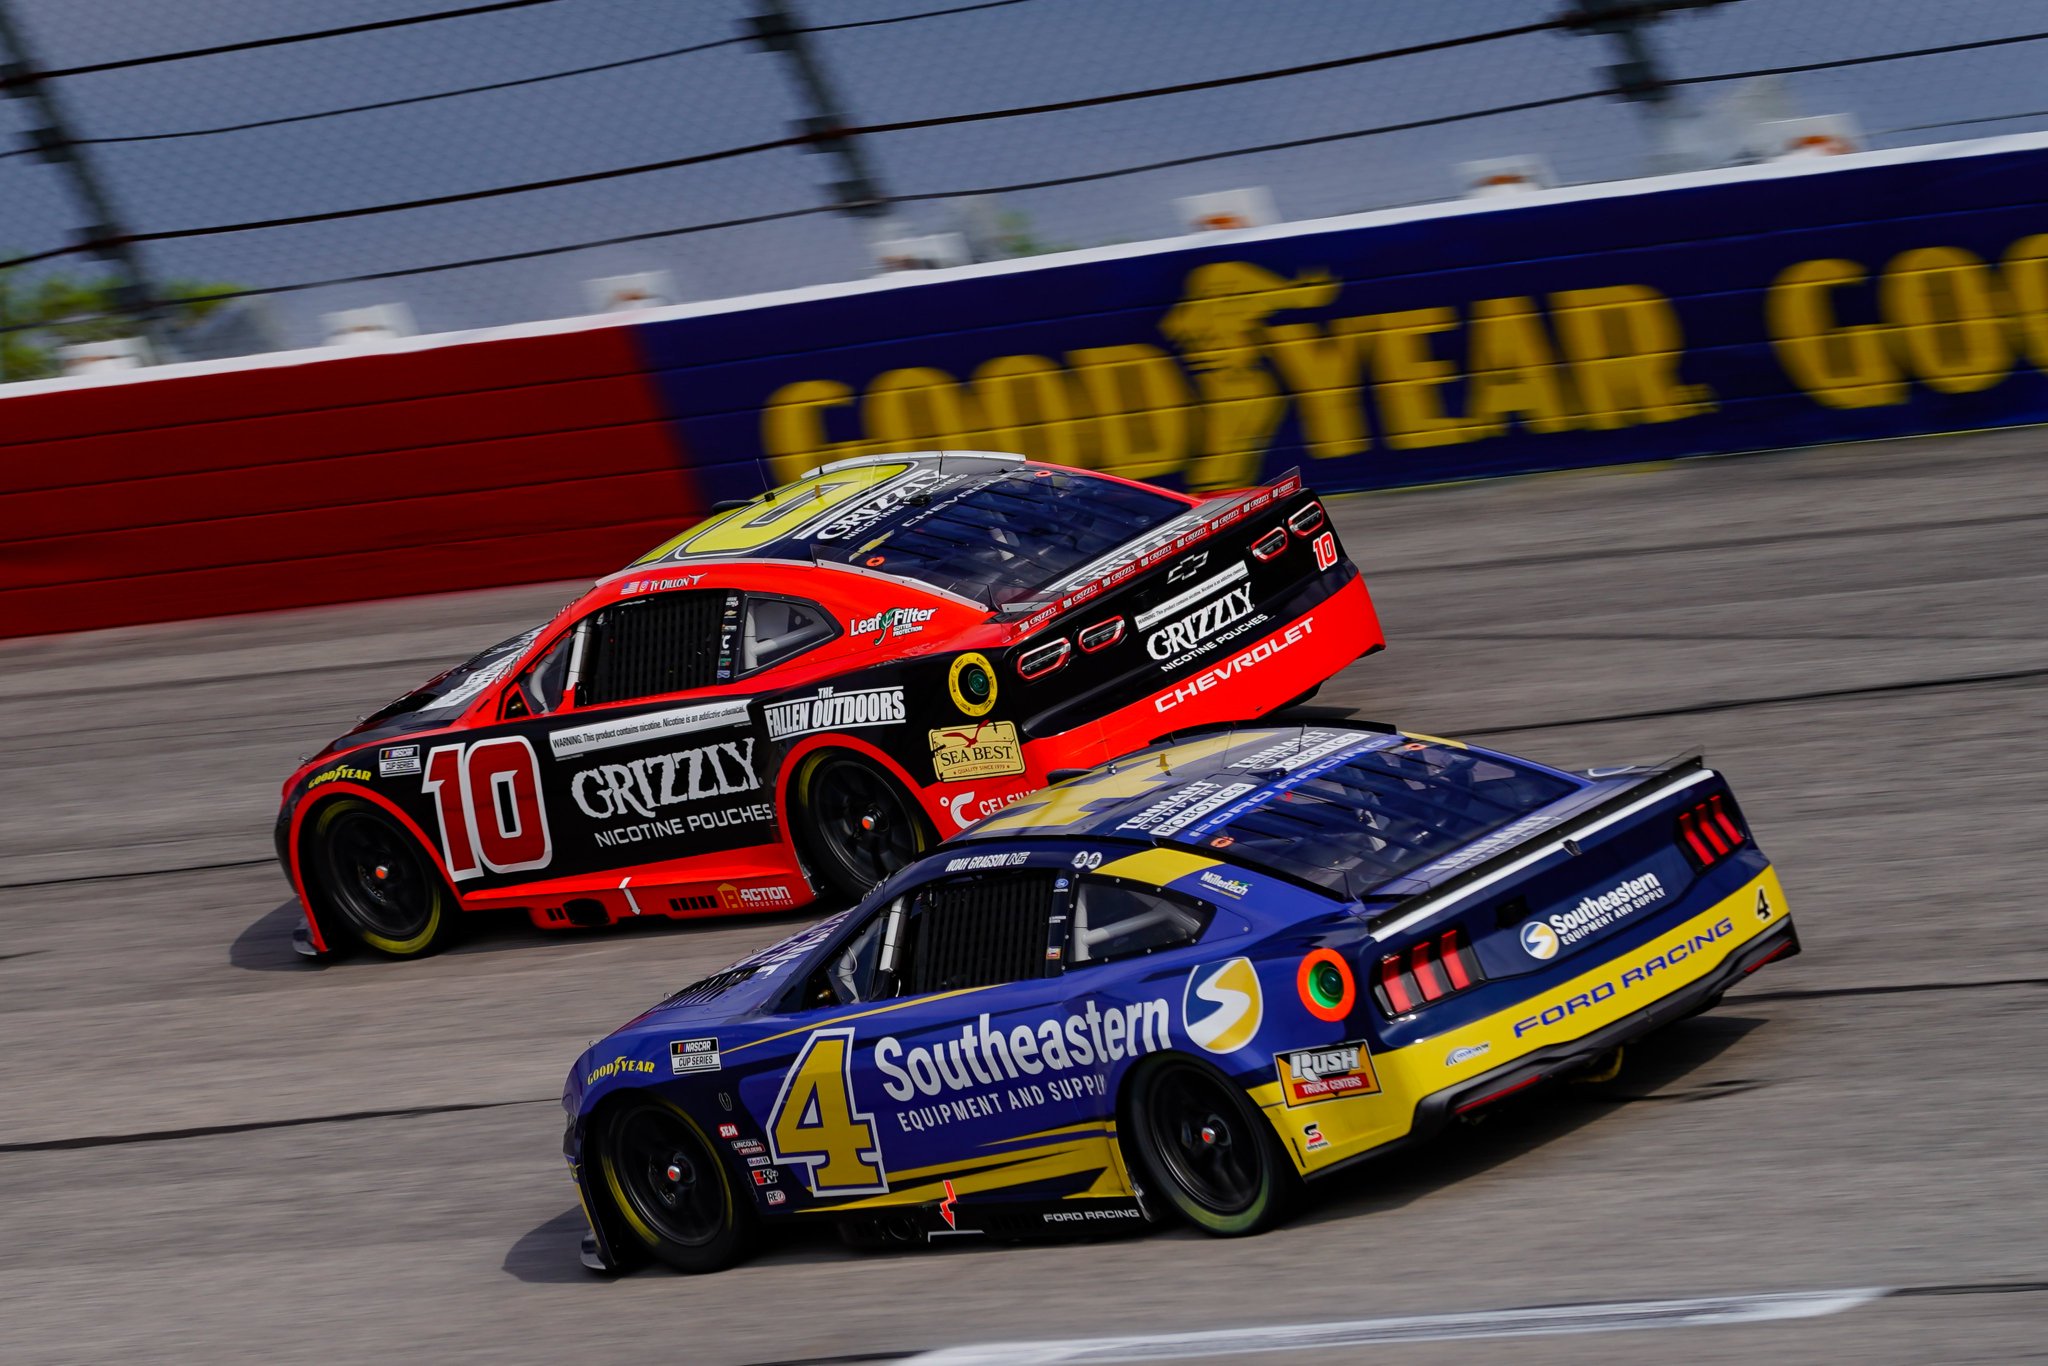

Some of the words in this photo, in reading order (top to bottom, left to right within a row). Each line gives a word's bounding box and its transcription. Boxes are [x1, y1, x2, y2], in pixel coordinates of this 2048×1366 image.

[817, 470, 953, 540] GRIZZLY
[842, 504, 904, 539] NICOTINE
[1312, 531, 1338, 571] 10
[660, 578, 689, 590] DILLON
[1146, 582, 1254, 661] GRIZZLY
[1161, 640, 1216, 672] NICOTINE
[1216, 614, 1268, 650] POUCHES
[1155, 617, 1314, 713] CHEVROLET
[818, 687, 834, 698] THE
[552, 734, 583, 749] WARNING:
[582, 732, 595, 743] This
[595, 728, 616, 743] product
[616, 724, 639, 736] contains
[639, 720, 662, 732] nicotine.
[662, 715, 685, 728] Nicotine
[764, 702, 810, 737] FALLEN
[812, 691, 906, 729] OUTDOORS
[940, 749, 971, 766] SEA
[972, 746, 1012, 761] BEST
[957, 766, 979, 775] QUALITY
[308, 764, 372, 788] GOODYEAR
[571, 738, 758, 818] GRIZZLY
[421, 735, 552, 882] 10
[1116, 779, 1215, 831] TENNANT
[1140, 783, 1223, 830] COMPANY
[1158, 784, 1248, 834] ROBOTICS
[594, 819, 686, 848] NICOTINE
[688, 804, 773, 832] POUCHES
[945, 858, 971, 872] NOAH
[968, 853, 1009, 869] GRAGSON
[740, 886, 791, 902] ACTION
[746, 900, 794, 908] INDUSTRIES
[1549, 872, 1661, 935] Southeastern
[1756, 888, 1771, 921] 4
[1561, 913, 1614, 945] EQUIPMENT
[1614, 904, 1634, 919] AND
[1632, 887, 1666, 909] SUPPLY
[1513, 982, 1616, 1038] FORD
[1621, 917, 1734, 989] RACING
[678, 1057, 692, 1067] CUP
[692, 1055, 713, 1065] SERIES
[685, 1040, 711, 1053] NASCAR
[874, 998, 1172, 1102] Southeastern
[587, 1056, 656, 1085] GOODYEAR
[1302, 1079, 1329, 1095] TRUCK
[1329, 1076, 1362, 1090] CENTERS
[766, 1027, 889, 1198] 4
[897, 1093, 1003, 1132] EQUIPMENT
[1007, 1085, 1045, 1110] AND
[719, 1124, 738, 1137] SEM
[733, 1140, 758, 1149] LINCOLN
[1043, 1211, 1084, 1222] FORD
[1084, 1209, 1140, 1221] RACING
